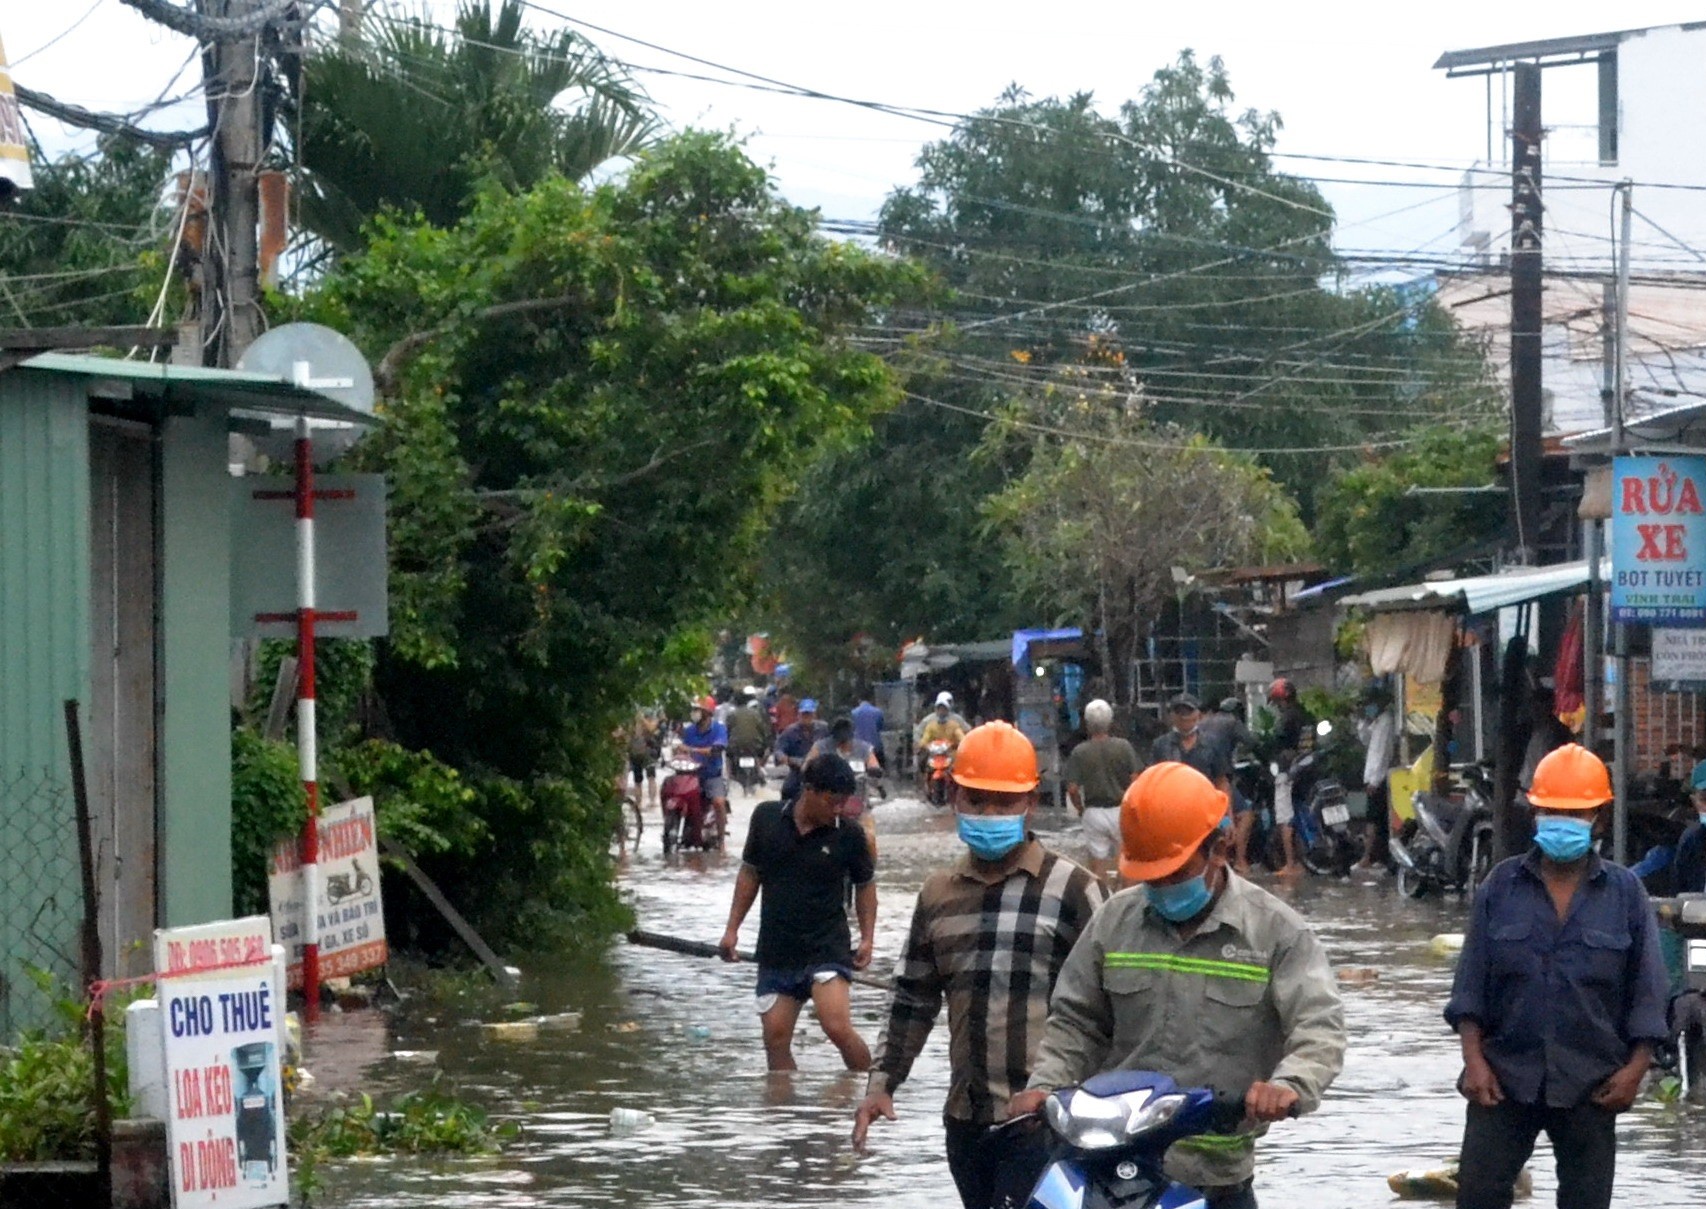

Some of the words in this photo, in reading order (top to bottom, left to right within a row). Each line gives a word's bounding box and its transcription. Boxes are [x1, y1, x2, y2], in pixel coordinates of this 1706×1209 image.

[1620, 461, 1704, 516] RỬA
[1635, 523, 1689, 563] XE
[1654, 566, 1704, 587] TUYẾT
[170, 994, 214, 1038] CHO
[218, 980, 272, 1034] THUÊ
[175, 1067, 203, 1120] LOA
[204, 1054, 233, 1117] KÉO
[180, 1141, 197, 1193] DI
[197, 1127, 237, 1201] ĐỘNG
